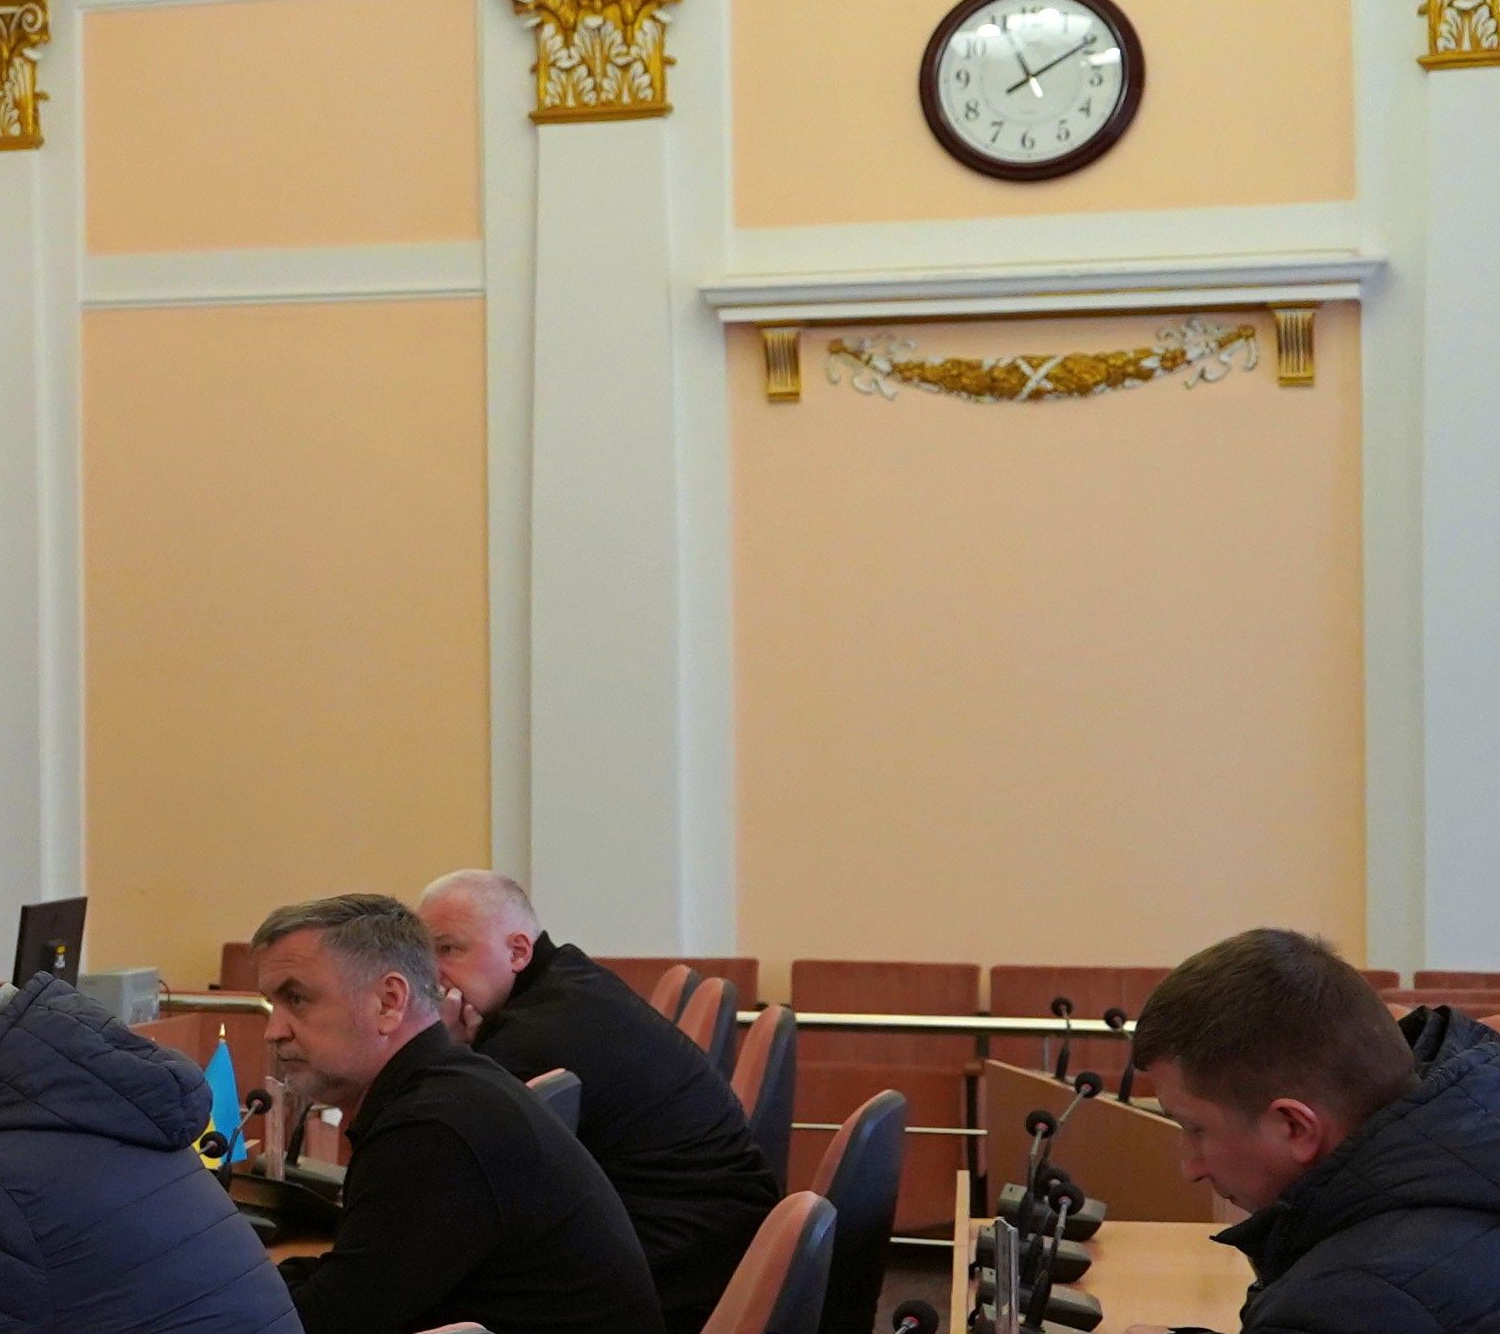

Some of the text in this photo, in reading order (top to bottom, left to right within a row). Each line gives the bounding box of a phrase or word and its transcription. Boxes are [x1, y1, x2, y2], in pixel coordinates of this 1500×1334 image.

[955, 67, 971, 90] 9
[963, 99, 980, 122] 8
[989, 120, 1005, 144] 7
[1020, 129, 1036, 151] 6
[1056, 119, 1071, 142] 5
